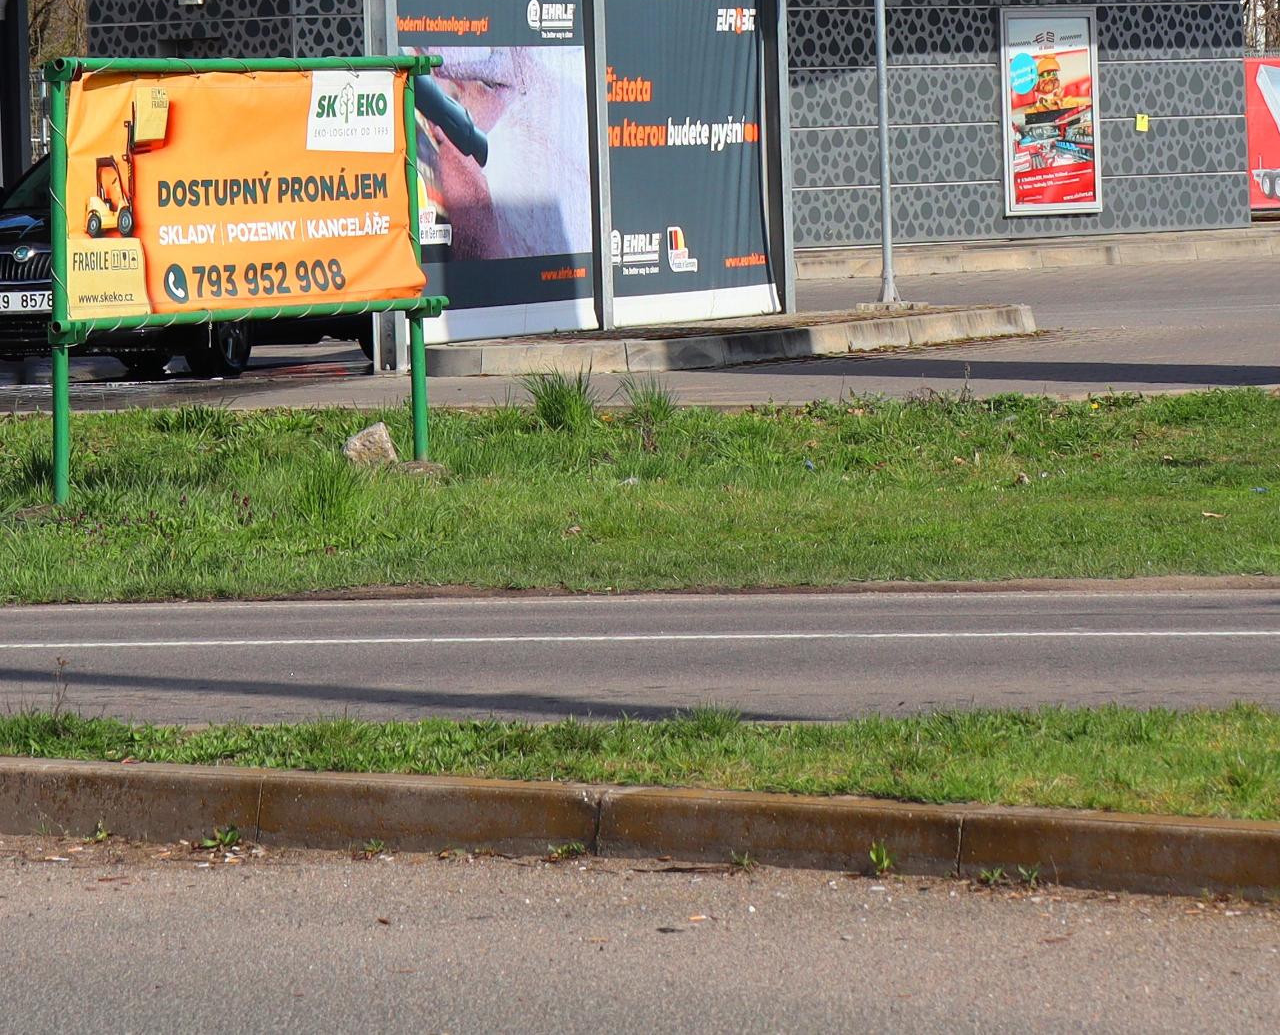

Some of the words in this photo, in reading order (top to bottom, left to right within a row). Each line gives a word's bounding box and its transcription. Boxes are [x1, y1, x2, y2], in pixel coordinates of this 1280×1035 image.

[542, 3, 574, 20] EHRLE
[426, 16, 470, 35] technologie
[470, 16, 489, 35] mytí
[315, 94, 338, 118] SK
[357, 93, 387, 116] EKO
[623, 118, 667, 147] kterou
[668, 117, 709, 146] budete
[711, 115, 745, 151] pyšní
[157, 170, 271, 207] DOSTUPNÝ
[278, 167, 388, 203] PRONÁJEM
[159, 223, 216, 245] SKLADY
[227, 220, 297, 242] POZEMKY
[306, 211, 391, 239] KANCELÁŘE
[624, 233, 660, 253] EHRLE
[73, 251, 109, 271] FRAGILE
[192, 264, 238, 298] 793
[244, 261, 291, 296] 952
[295, 258, 346, 293] 908
[21, 293, 53, 309] 8578
[78, 291, 134, 303] www.skeko.cz
